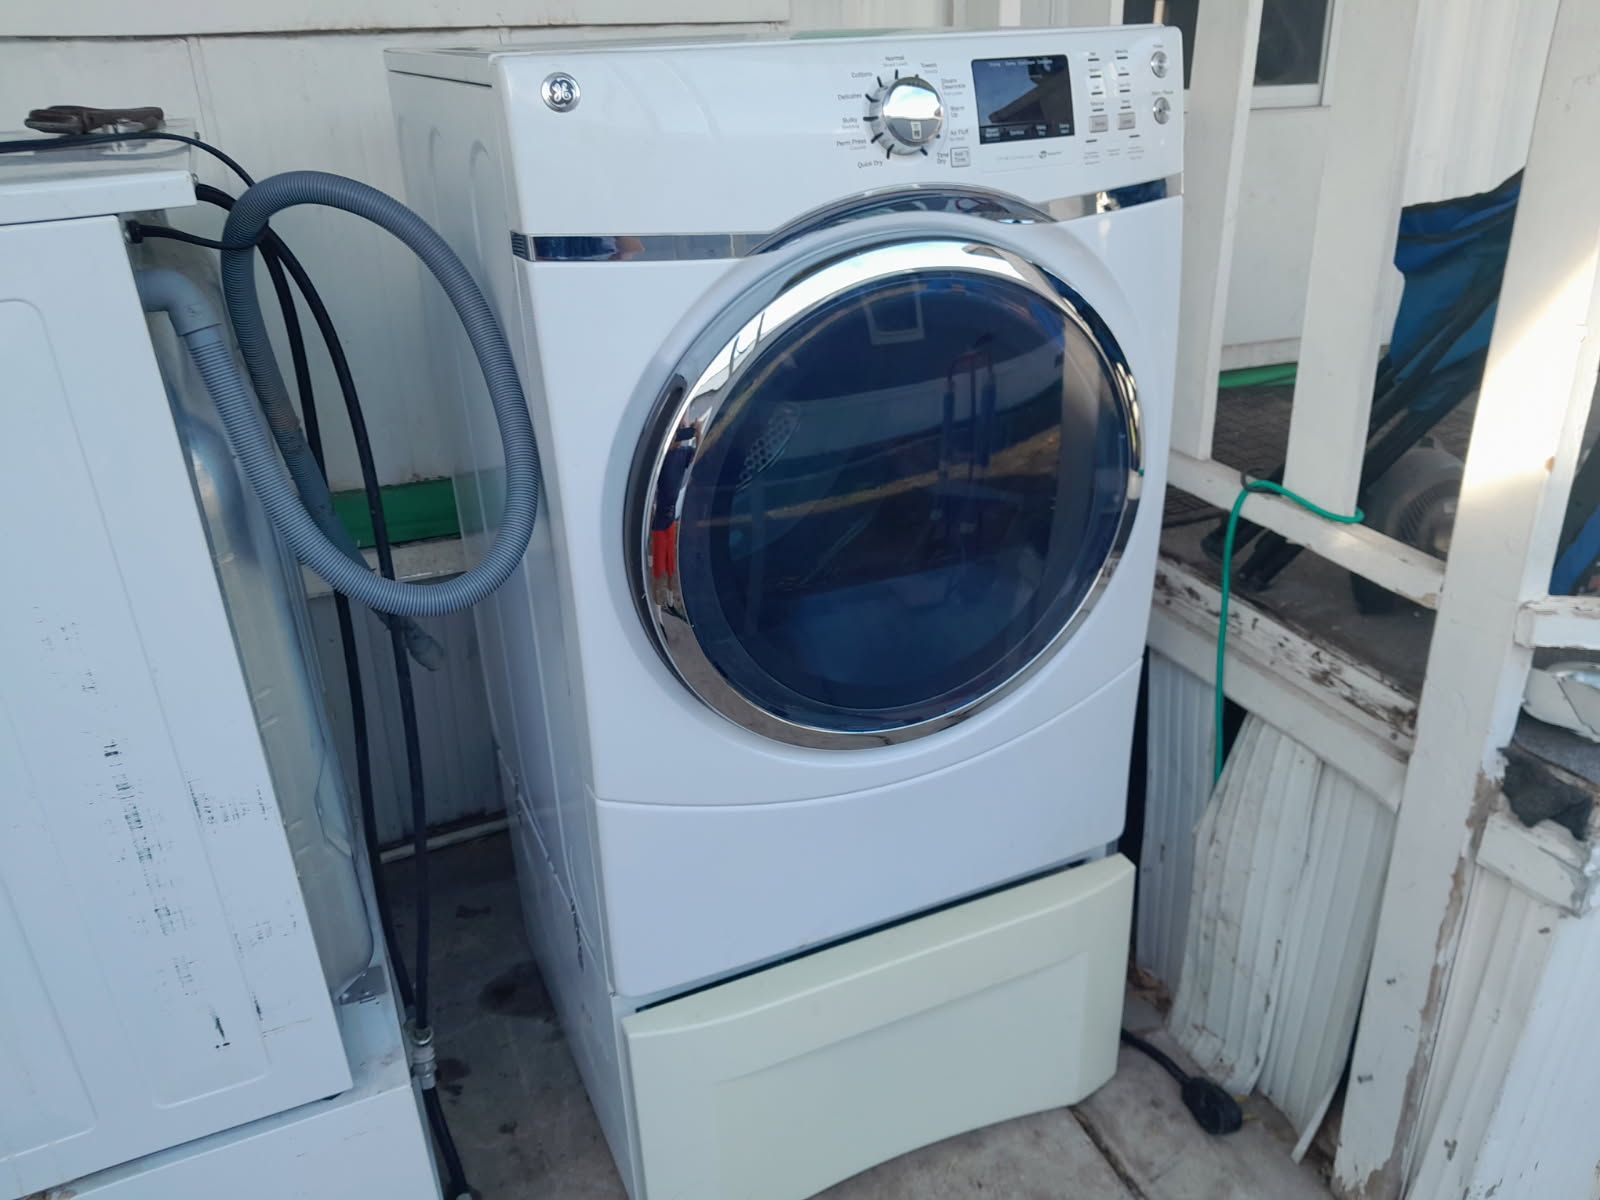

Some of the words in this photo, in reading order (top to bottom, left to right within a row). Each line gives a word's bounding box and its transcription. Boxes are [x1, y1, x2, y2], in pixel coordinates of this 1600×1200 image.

[837, 92, 863, 100] Delicates
[857, 160, 873, 169] Quick
[873, 159, 883, 167] Dry
